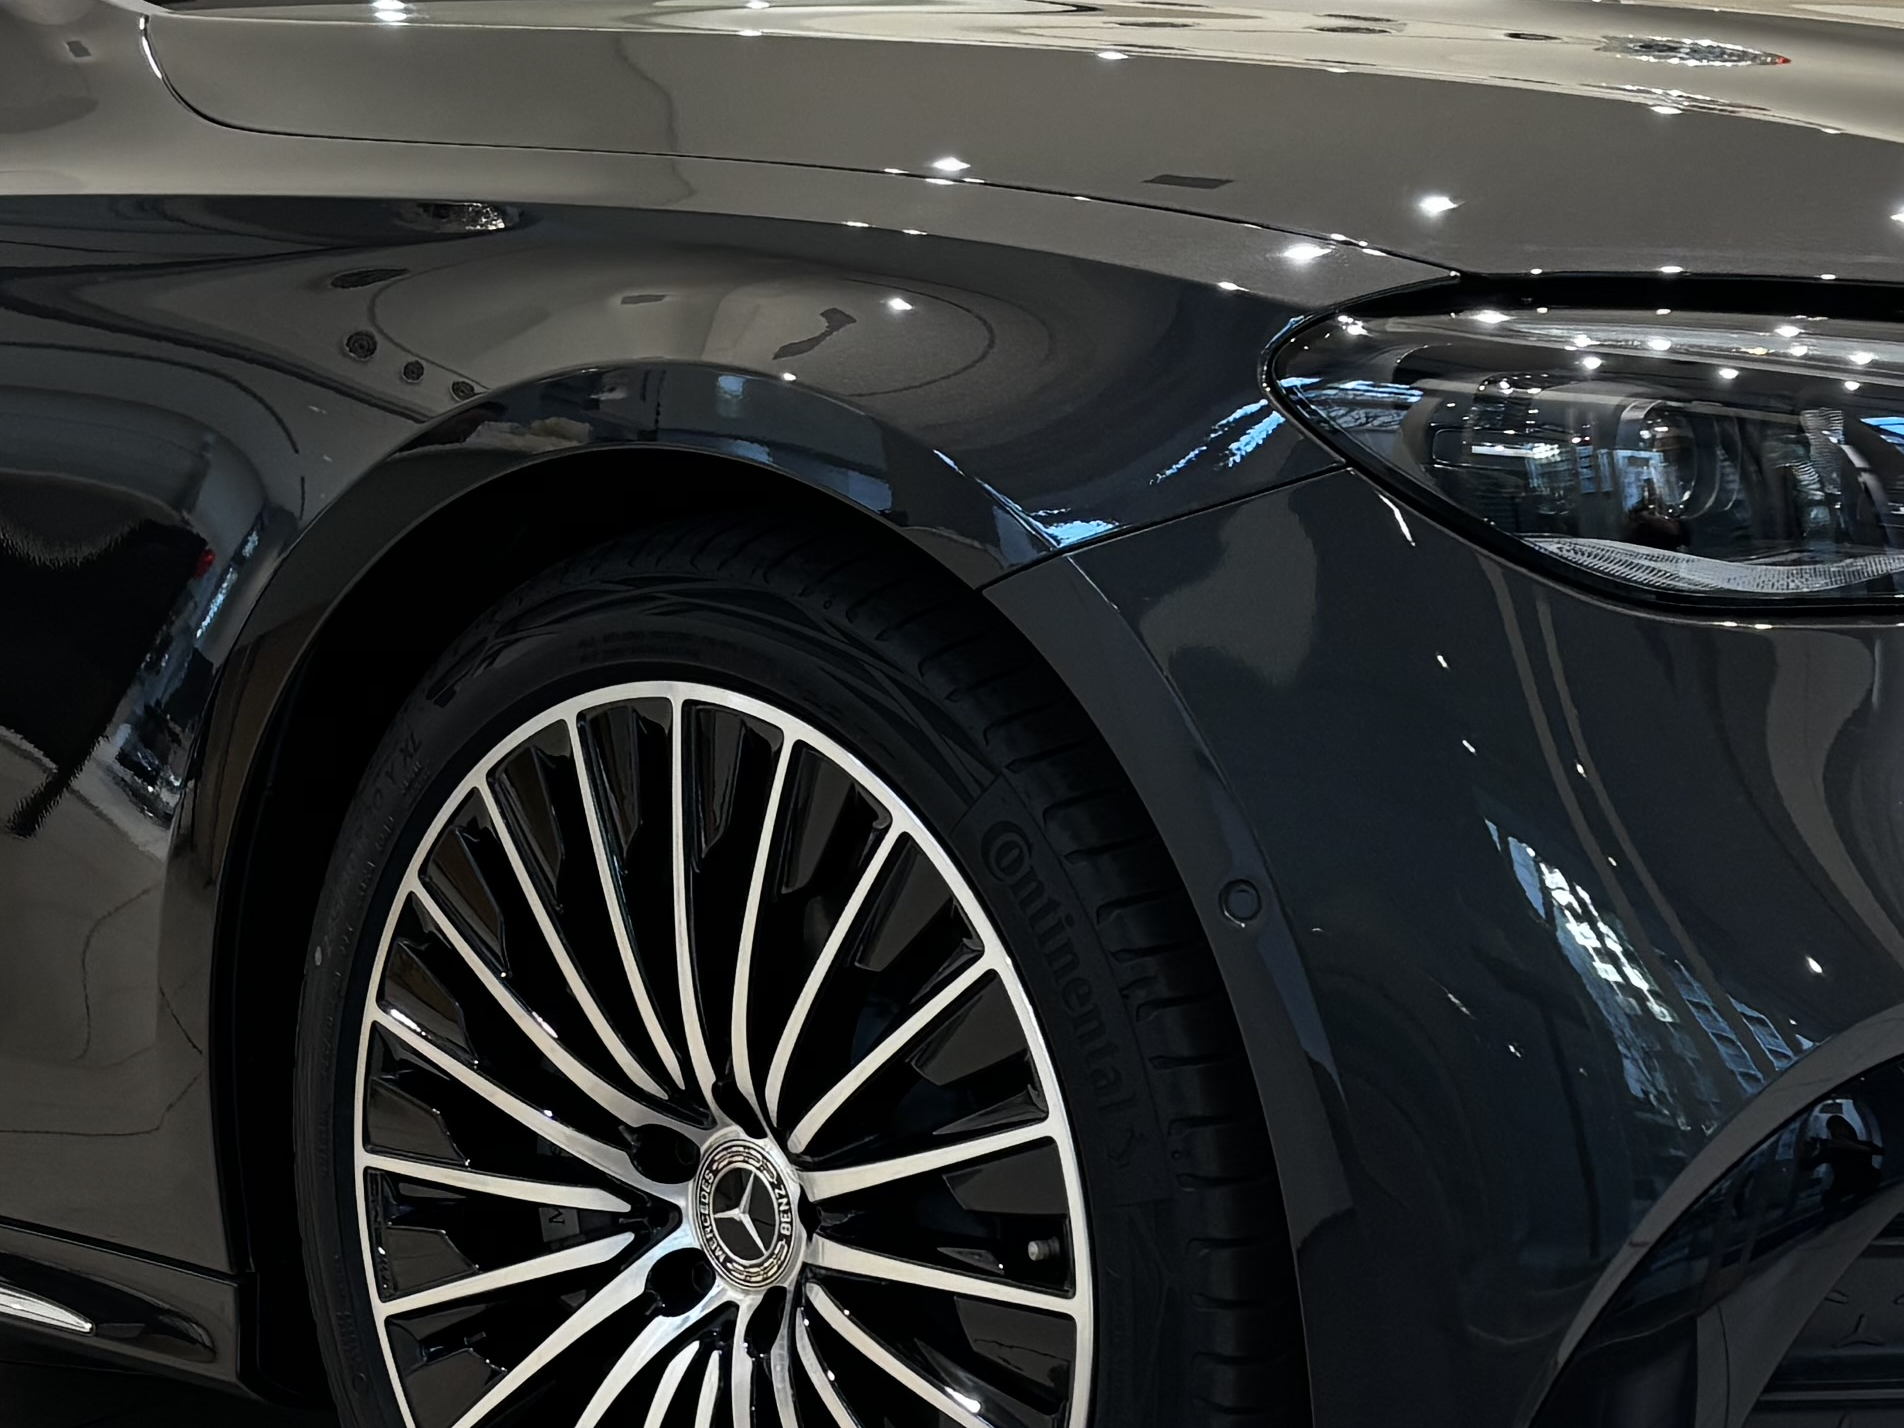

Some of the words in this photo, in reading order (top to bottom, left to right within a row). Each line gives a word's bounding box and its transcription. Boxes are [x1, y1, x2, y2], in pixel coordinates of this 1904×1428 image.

[980, 819, 1137, 1112] Continental
[697, 1168, 727, 1265] MERCEDES
[773, 1183, 793, 1236] BENZ
